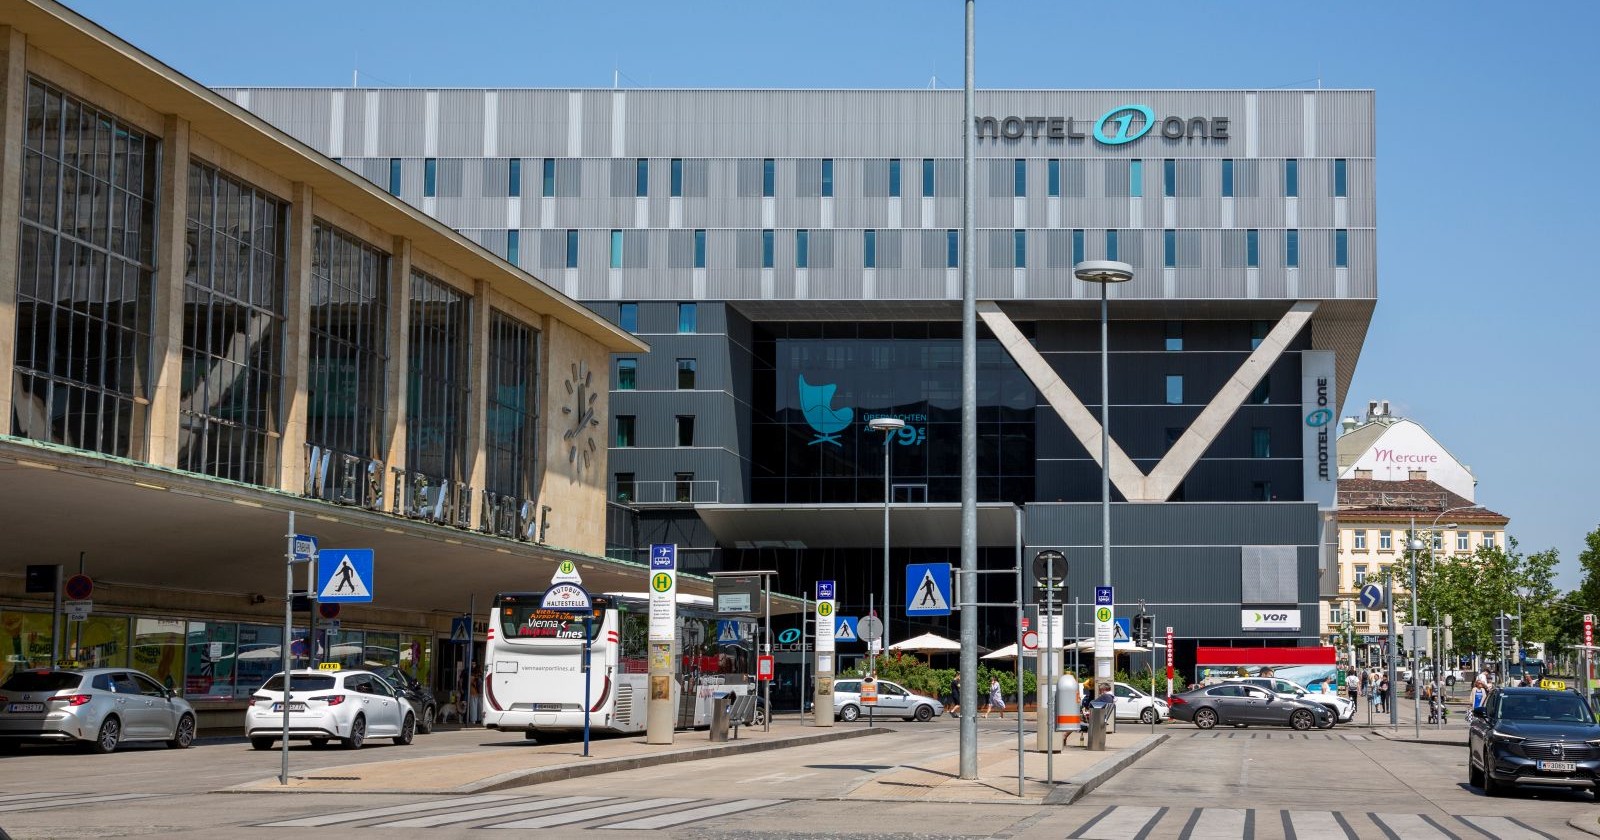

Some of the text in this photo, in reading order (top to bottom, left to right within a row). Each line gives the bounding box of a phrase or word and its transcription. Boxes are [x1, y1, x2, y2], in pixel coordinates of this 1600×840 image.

[1162, 115, 1229, 138] ONE
[1317, 378, 1327, 406] ONE
[1318, 428, 1330, 481] MOTEL
[1374, 447, 1438, 463] Mercure
[303, 443, 553, 546] WESTBAHNHOF
[552, 587, 580, 596] AUTOBUS
[528, 618, 558, 628] Vienna
[1263, 613, 1288, 621] VOR
[556, 629, 583, 639] Lines
[522, 665, 575, 673] viennaairportlines.at
